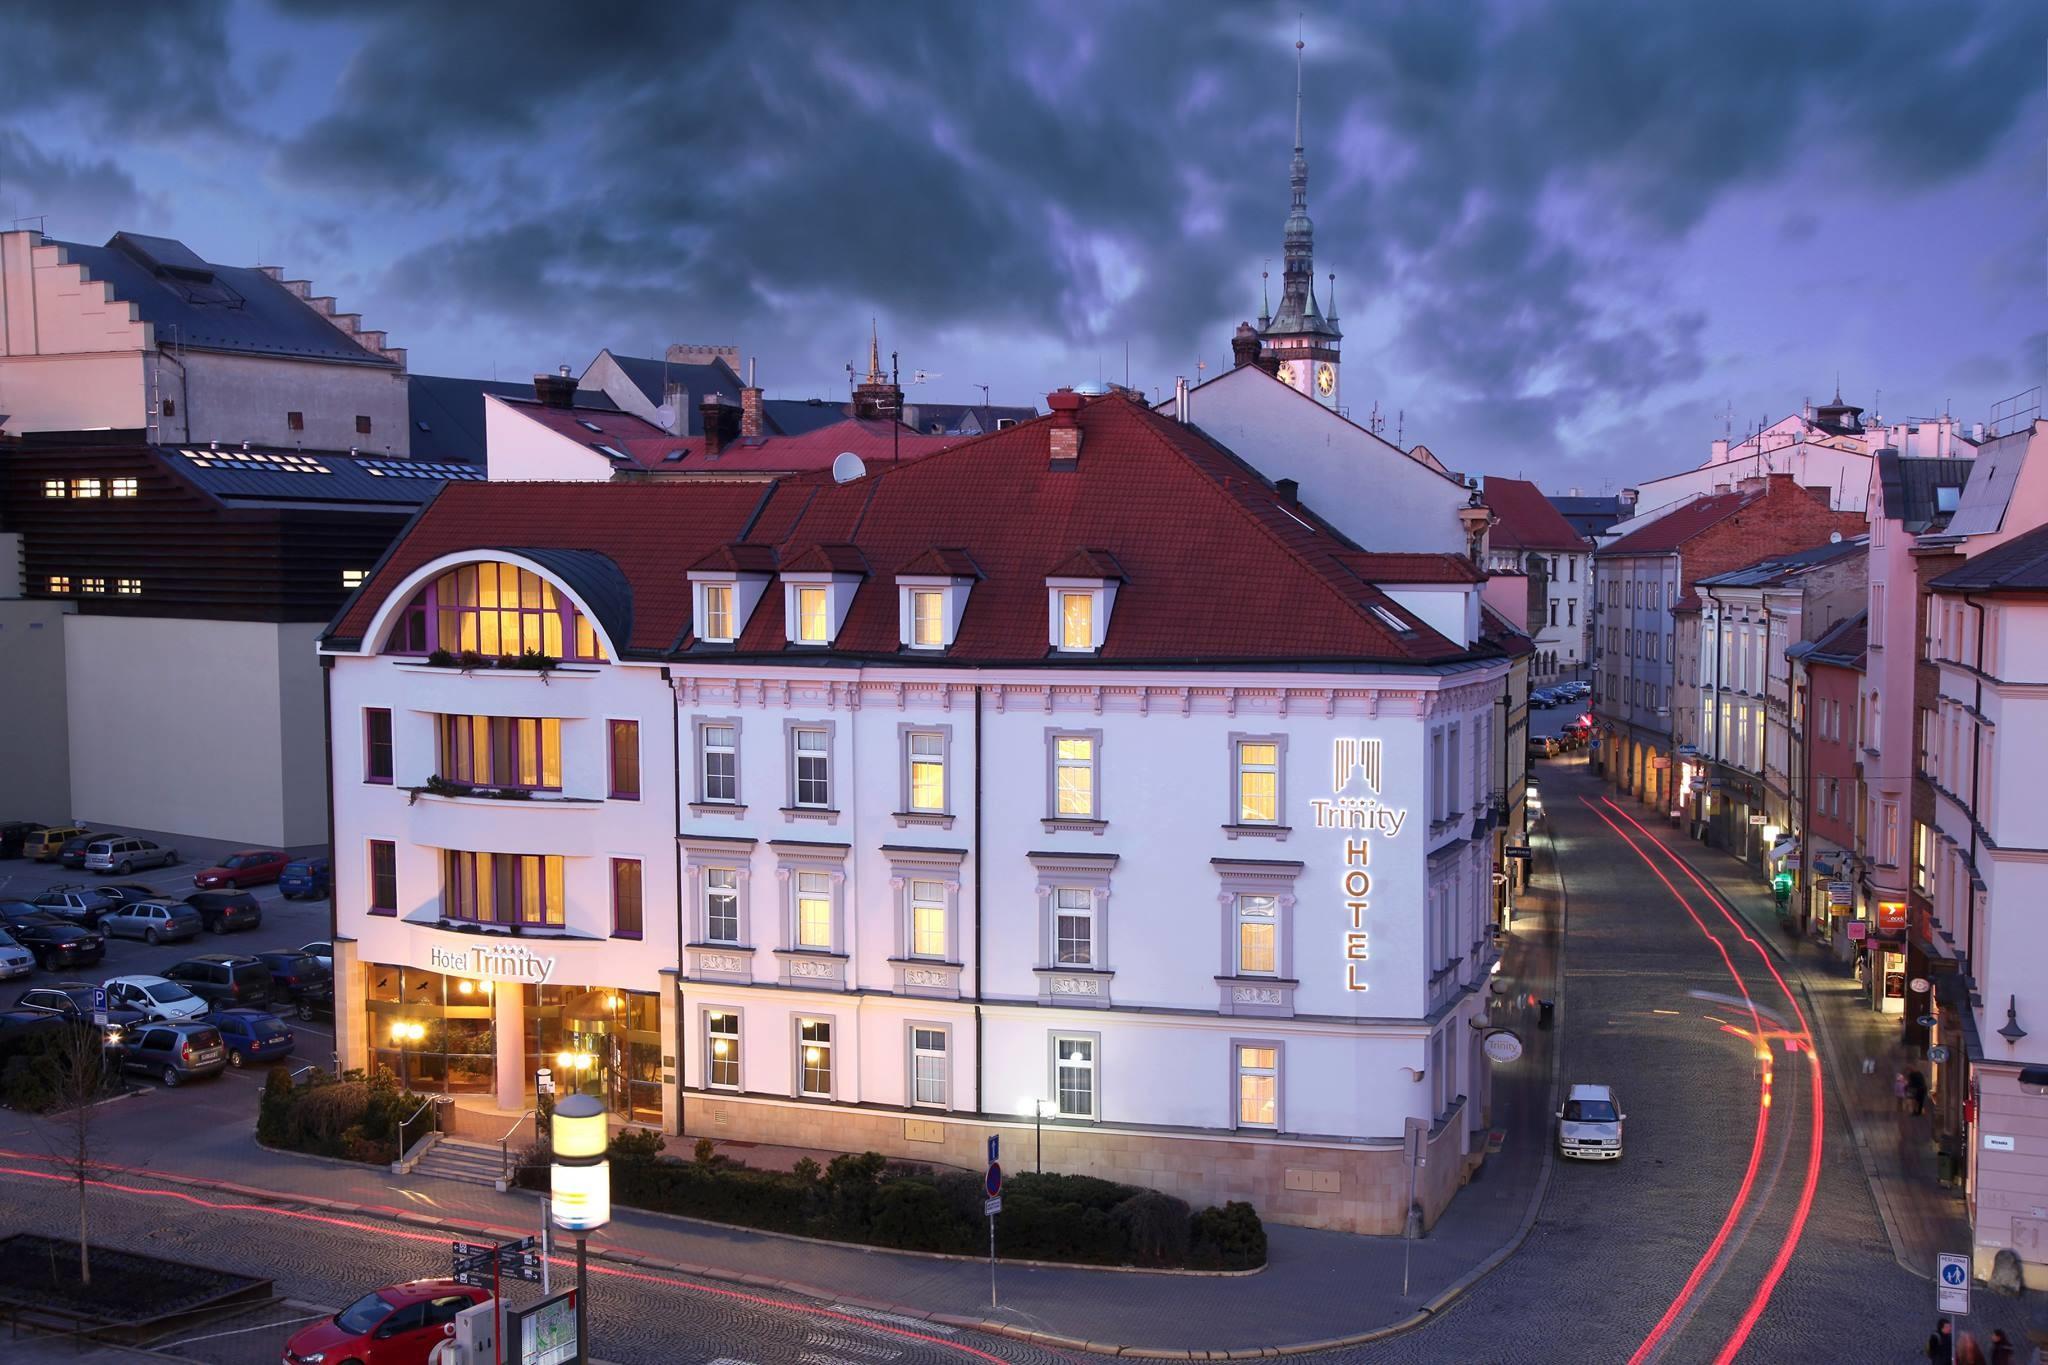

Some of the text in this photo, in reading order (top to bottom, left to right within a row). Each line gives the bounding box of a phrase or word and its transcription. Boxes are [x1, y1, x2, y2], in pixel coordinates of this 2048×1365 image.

[1311, 801, 1406, 836] Trinity
[1345, 840, 1370, 991] HOTEL
[431, 946, 552, 984] Hotel Trinity
[95, 990, 104, 1006] P
[1488, 1039, 1518, 1052] Trinity
